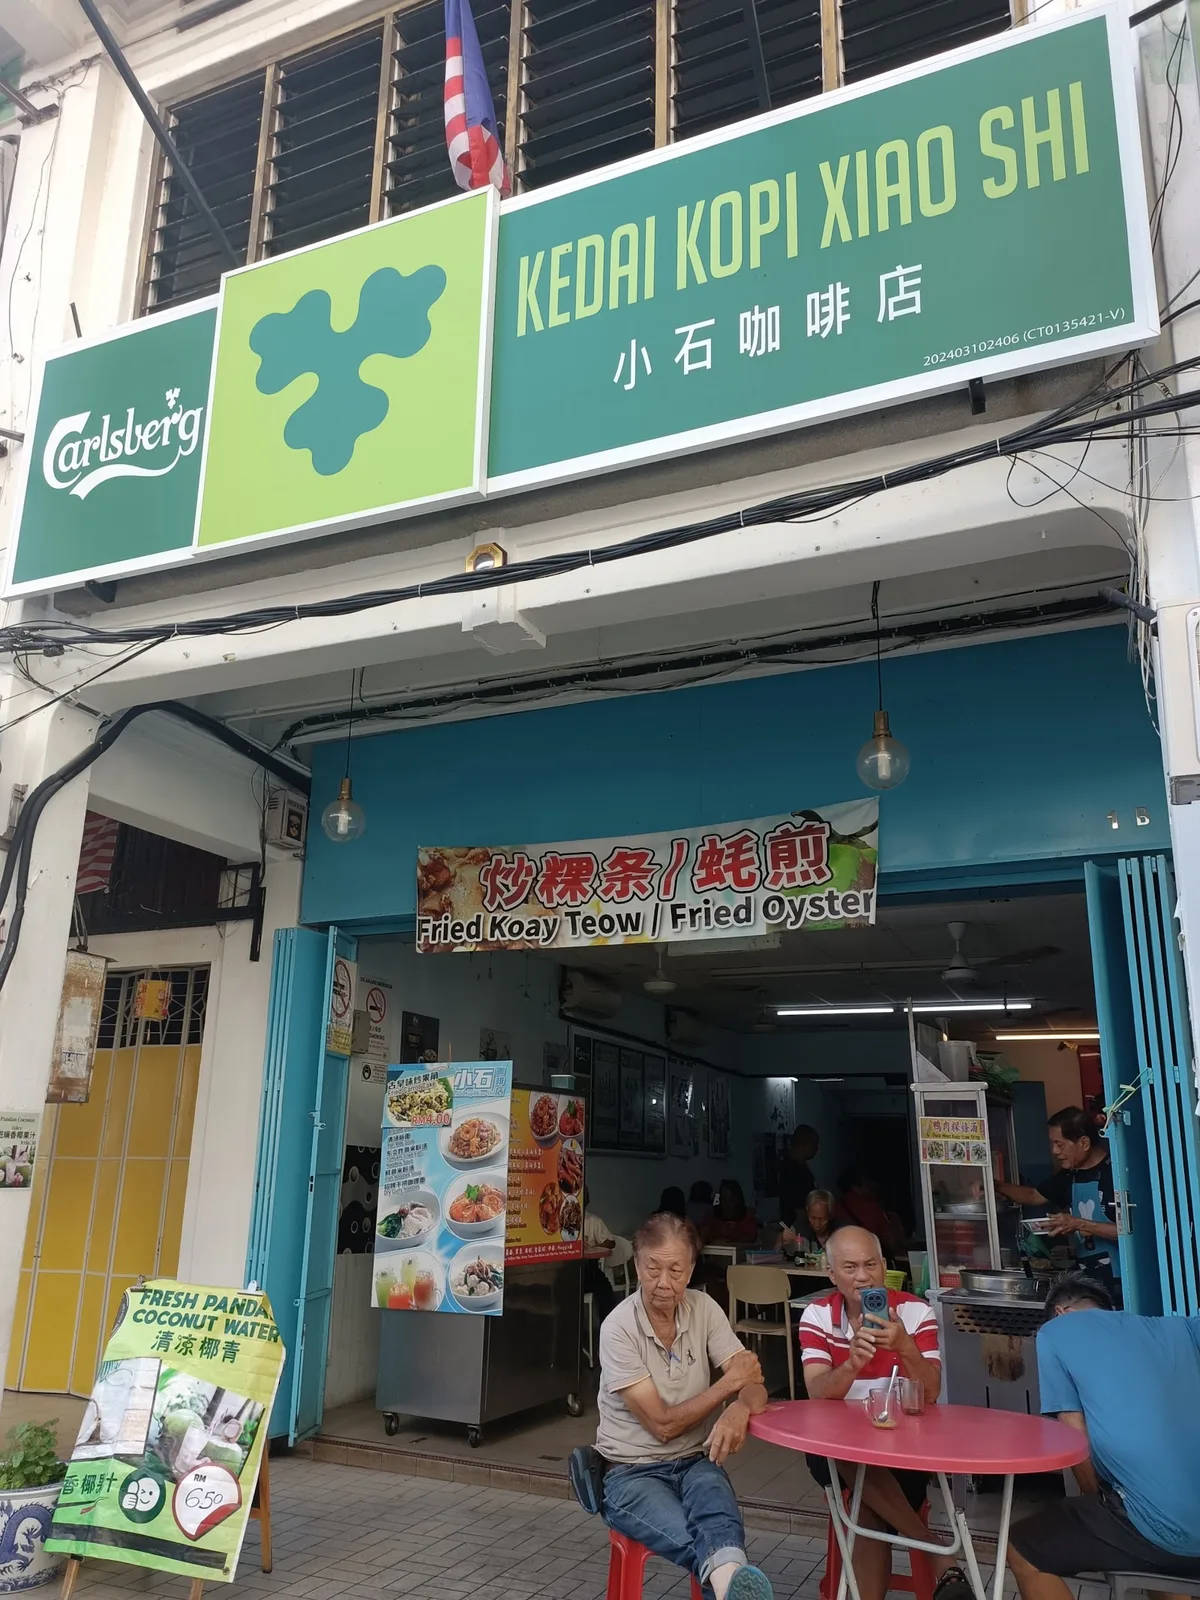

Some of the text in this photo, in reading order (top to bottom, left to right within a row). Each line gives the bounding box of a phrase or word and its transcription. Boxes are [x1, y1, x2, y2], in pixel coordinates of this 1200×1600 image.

[516, 81, 1091, 337] KEDAI KOPI XIAO SHI
[612, 263, 923, 391] 小石咖啡店
[923, 307, 1126, 368] 202403102406 (CT0135421-V)
[43, 404, 203, 491] Carlsberg
[417, 914, 481, 943] Fried
[489, 914, 559, 943] Koay
[565, 910, 642, 937] Teow
[670, 896, 752, 930] Fried
[762, 890, 874, 927] Oyster
[132, 1309, 219, 1332] COCONUT
[224, 1318, 281, 1344] WATER
[139, 1287, 274, 1321] FRESH PANDA
[193, 1473, 207, 1483] RM
